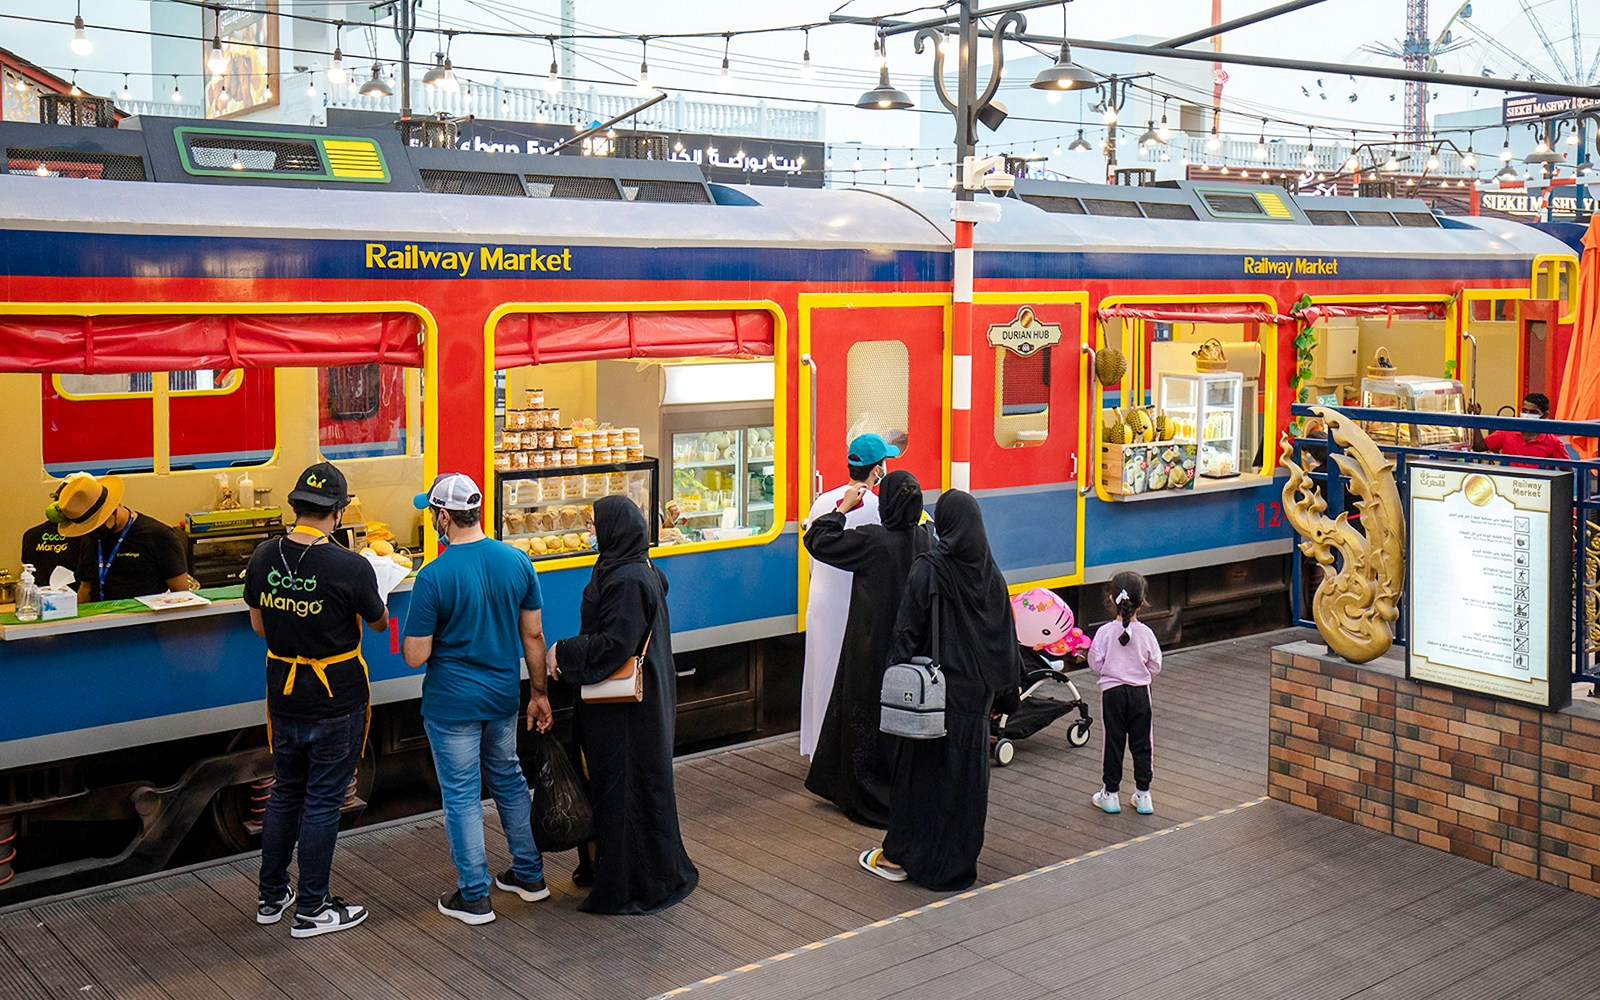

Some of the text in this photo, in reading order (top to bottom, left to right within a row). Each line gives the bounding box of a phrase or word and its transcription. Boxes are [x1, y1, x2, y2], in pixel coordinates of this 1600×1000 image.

[1506, 104, 1533, 117] SIEKH
[1533, 99, 1572, 114] MASHWY
[1482, 194, 1594, 213] SIEKH MSHY
[365, 243, 572, 277] Railway Market
[1243, 256, 1338, 280] Railway Market
[1002, 329, 1050, 341] DURIAN HUB
[1512, 479, 1543, 490] Railway
[1512, 488, 1541, 498] Market
[36, 541, 68, 554] Mango
[266, 566, 318, 592] Coco
[259, 591, 324, 618] Mango
